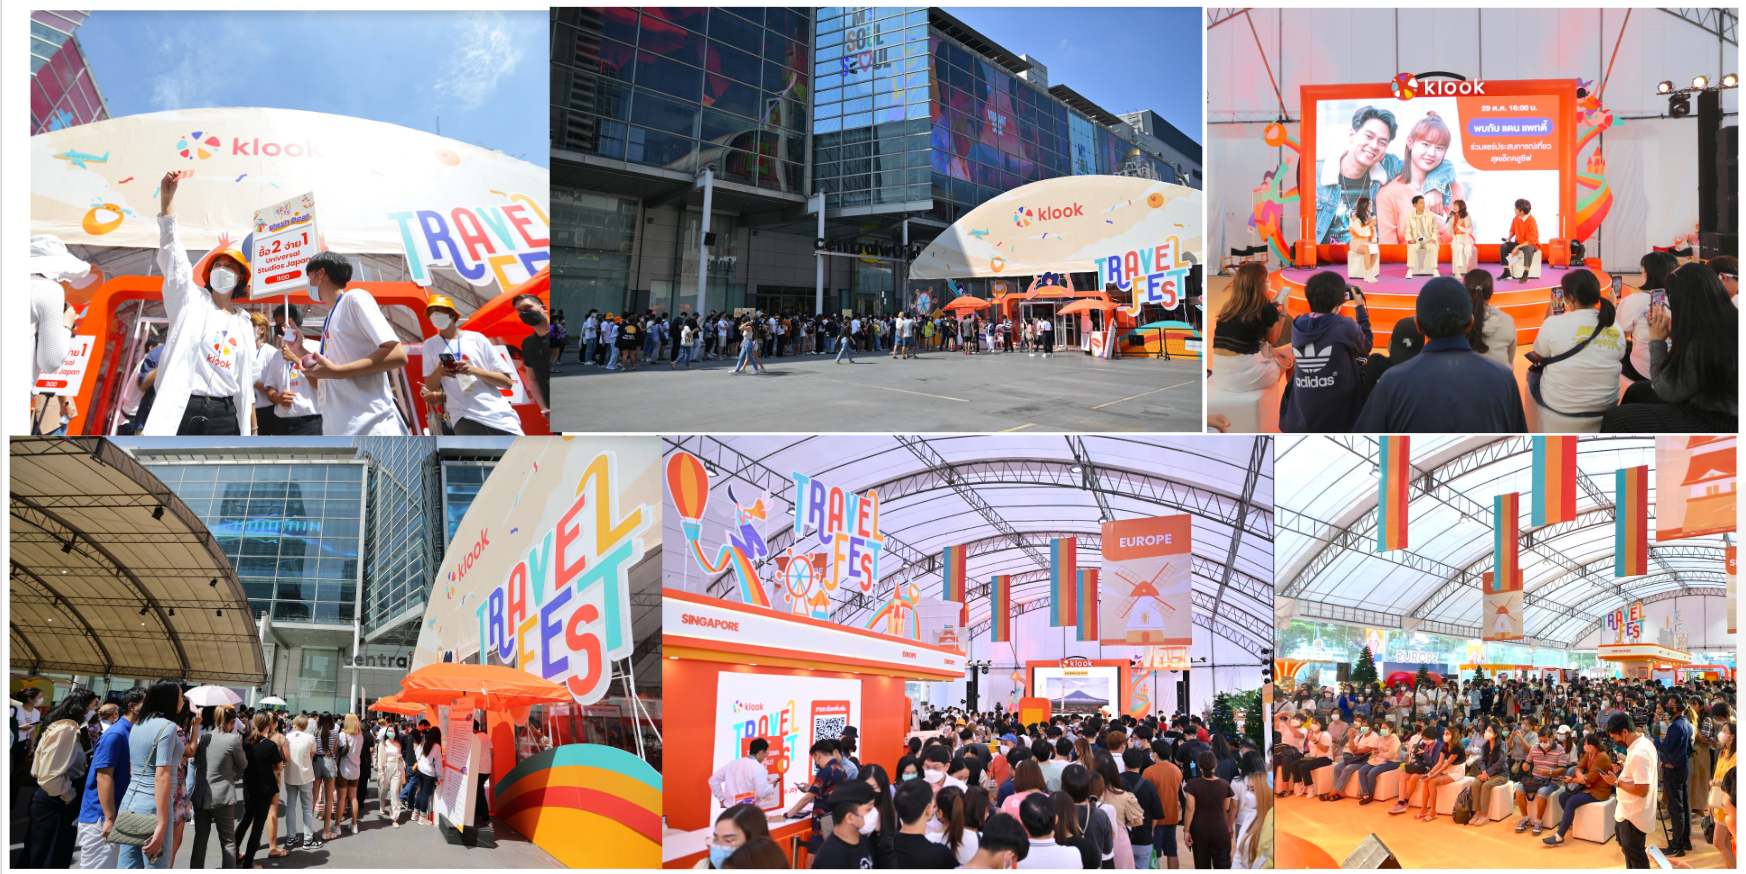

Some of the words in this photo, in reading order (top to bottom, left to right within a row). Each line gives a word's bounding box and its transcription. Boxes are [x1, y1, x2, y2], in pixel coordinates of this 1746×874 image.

[1424, 78, 1485, 95] klook
[1509, 104, 1529, 112] 16:00
[1474, 123, 1500, 133] พบกับ
[232, 137, 325, 158] klook
[1038, 202, 1084, 222] klook
[259, 246, 271, 257] ซื้อ
[271, 240, 281, 254] 2
[284, 240, 302, 252] จ่าย
[301, 232, 308, 246] 1
[257, 262, 285, 275] Studios
[286, 256, 311, 269] Japan
[265, 250, 301, 264] Universal
[1094, 235, 1190, 290] TRAVEL
[1126, 268, 1187, 315] FEST
[81, 343, 88, 357] 1
[206, 353, 231, 370] klook
[59, 369, 81, 377] Japan
[1296, 376, 1334, 388] adidas
[792, 471, 884, 545] TRAVEL
[1119, 533, 1172, 548] EUROPE
[458, 527, 490, 582] klook
[476, 454, 642, 665] TRAVEL
[823, 532, 882, 592] FEST
[518, 538, 633, 696] FEST
[681, 613, 740, 632] SINGAPORE
[1601, 601, 1646, 632] TRAVEL
[1615, 619, 1644, 644] FEST
[343, 653, 407, 668] centra
[902, 650, 917, 659] EUROPE
[1397, 650, 1438, 664] EUROPE
[744, 702, 764, 711] klook
